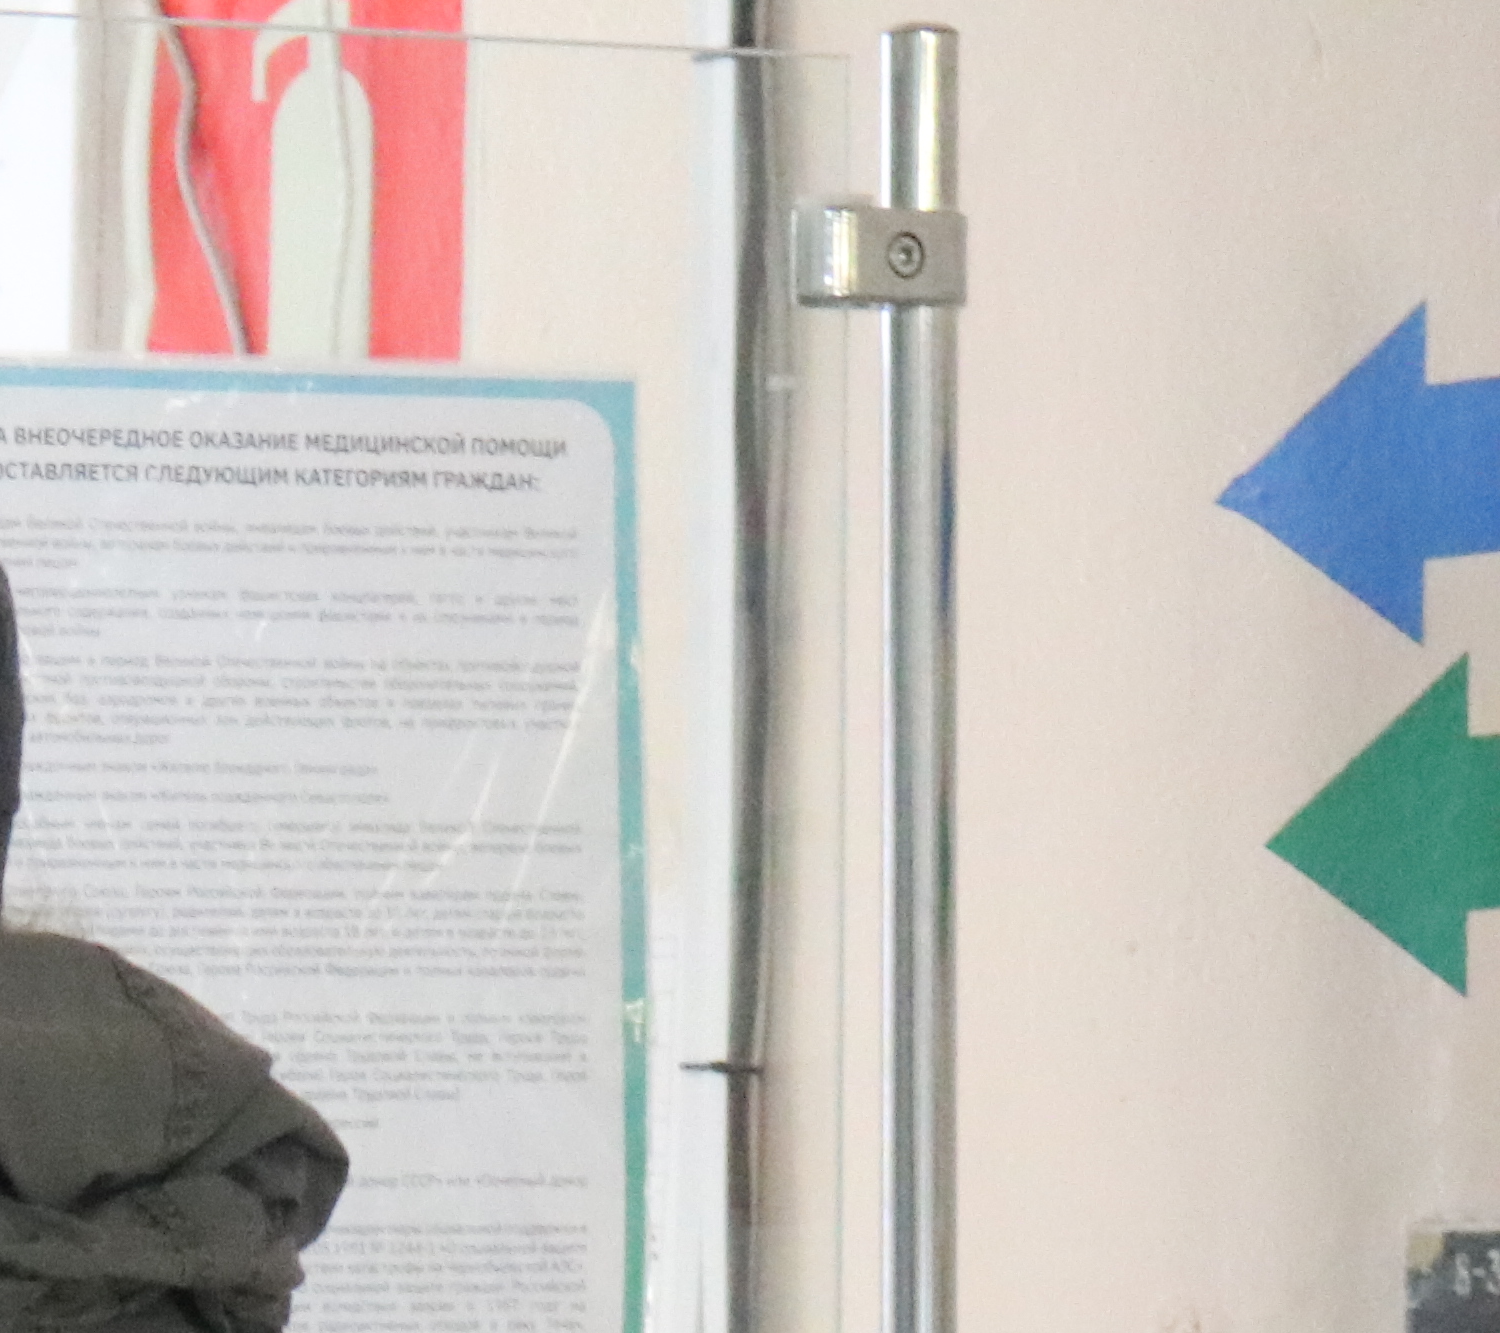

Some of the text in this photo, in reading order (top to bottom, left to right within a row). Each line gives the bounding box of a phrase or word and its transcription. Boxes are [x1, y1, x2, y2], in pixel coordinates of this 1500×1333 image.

[14, 426, 184, 449] ВНЕОЧЕРЕДНОЕ
[189, 429, 299, 450] ОКАЗАНИЕ
[305, 431, 466, 456] МЕДИЦИНСКОЙ
[471, 435, 568, 460] ПОМОЩИ
[145, 463, 289, 487] СЛЕДУЮЩИМ
[295, 466, 427, 489] КАТЕГОРИЯМ
[434, 470, 542, 492] ГРАЖДАН:
